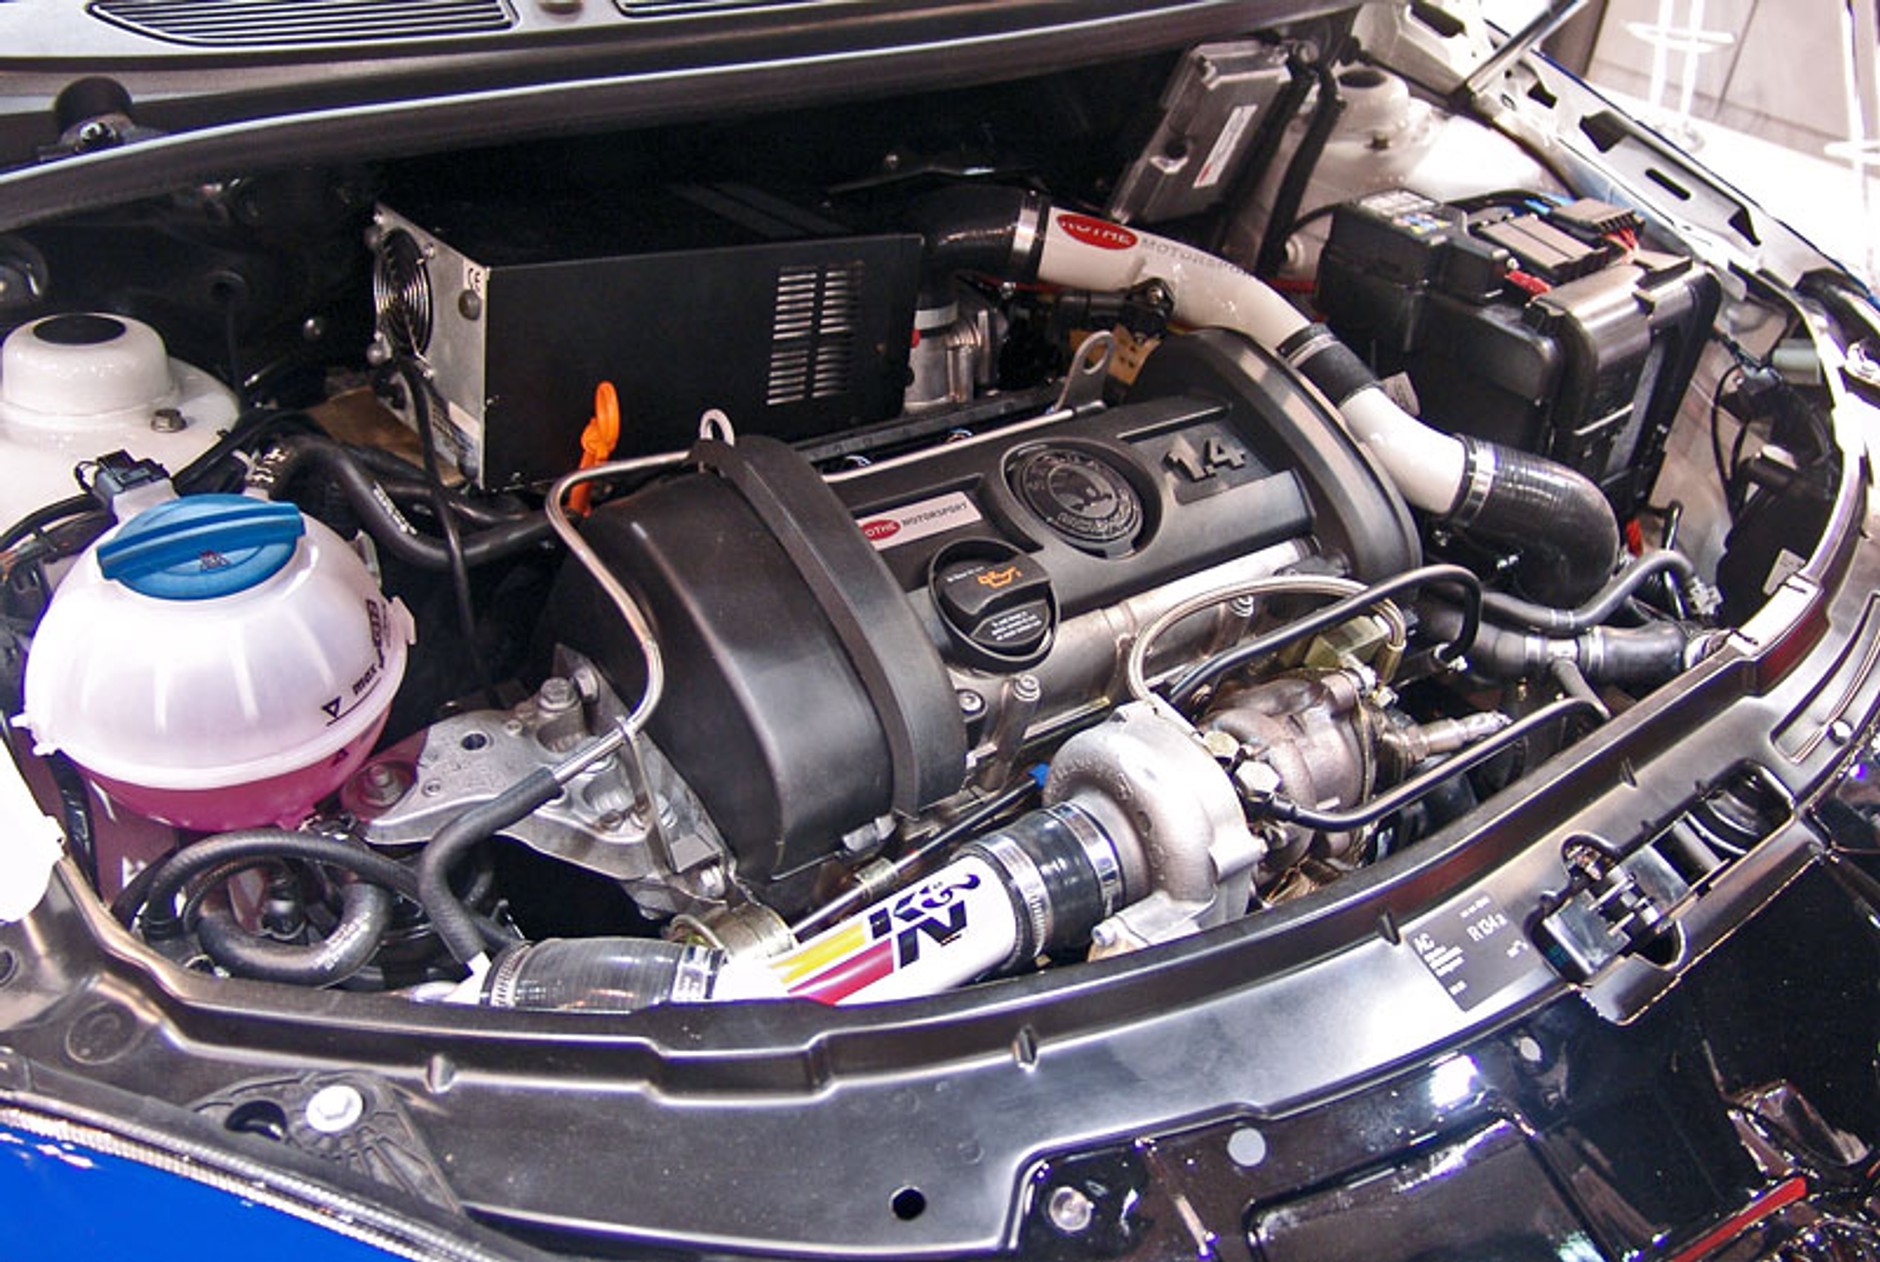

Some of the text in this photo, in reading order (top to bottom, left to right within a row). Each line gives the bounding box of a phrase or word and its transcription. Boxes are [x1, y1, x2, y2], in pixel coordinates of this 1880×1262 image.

[1163, 437, 1246, 482] 1.4
[863, 501, 968, 538] OTHE MOTORSPORT
[352, 662, 378, 696] max
[869, 873, 981, 969] K&N
